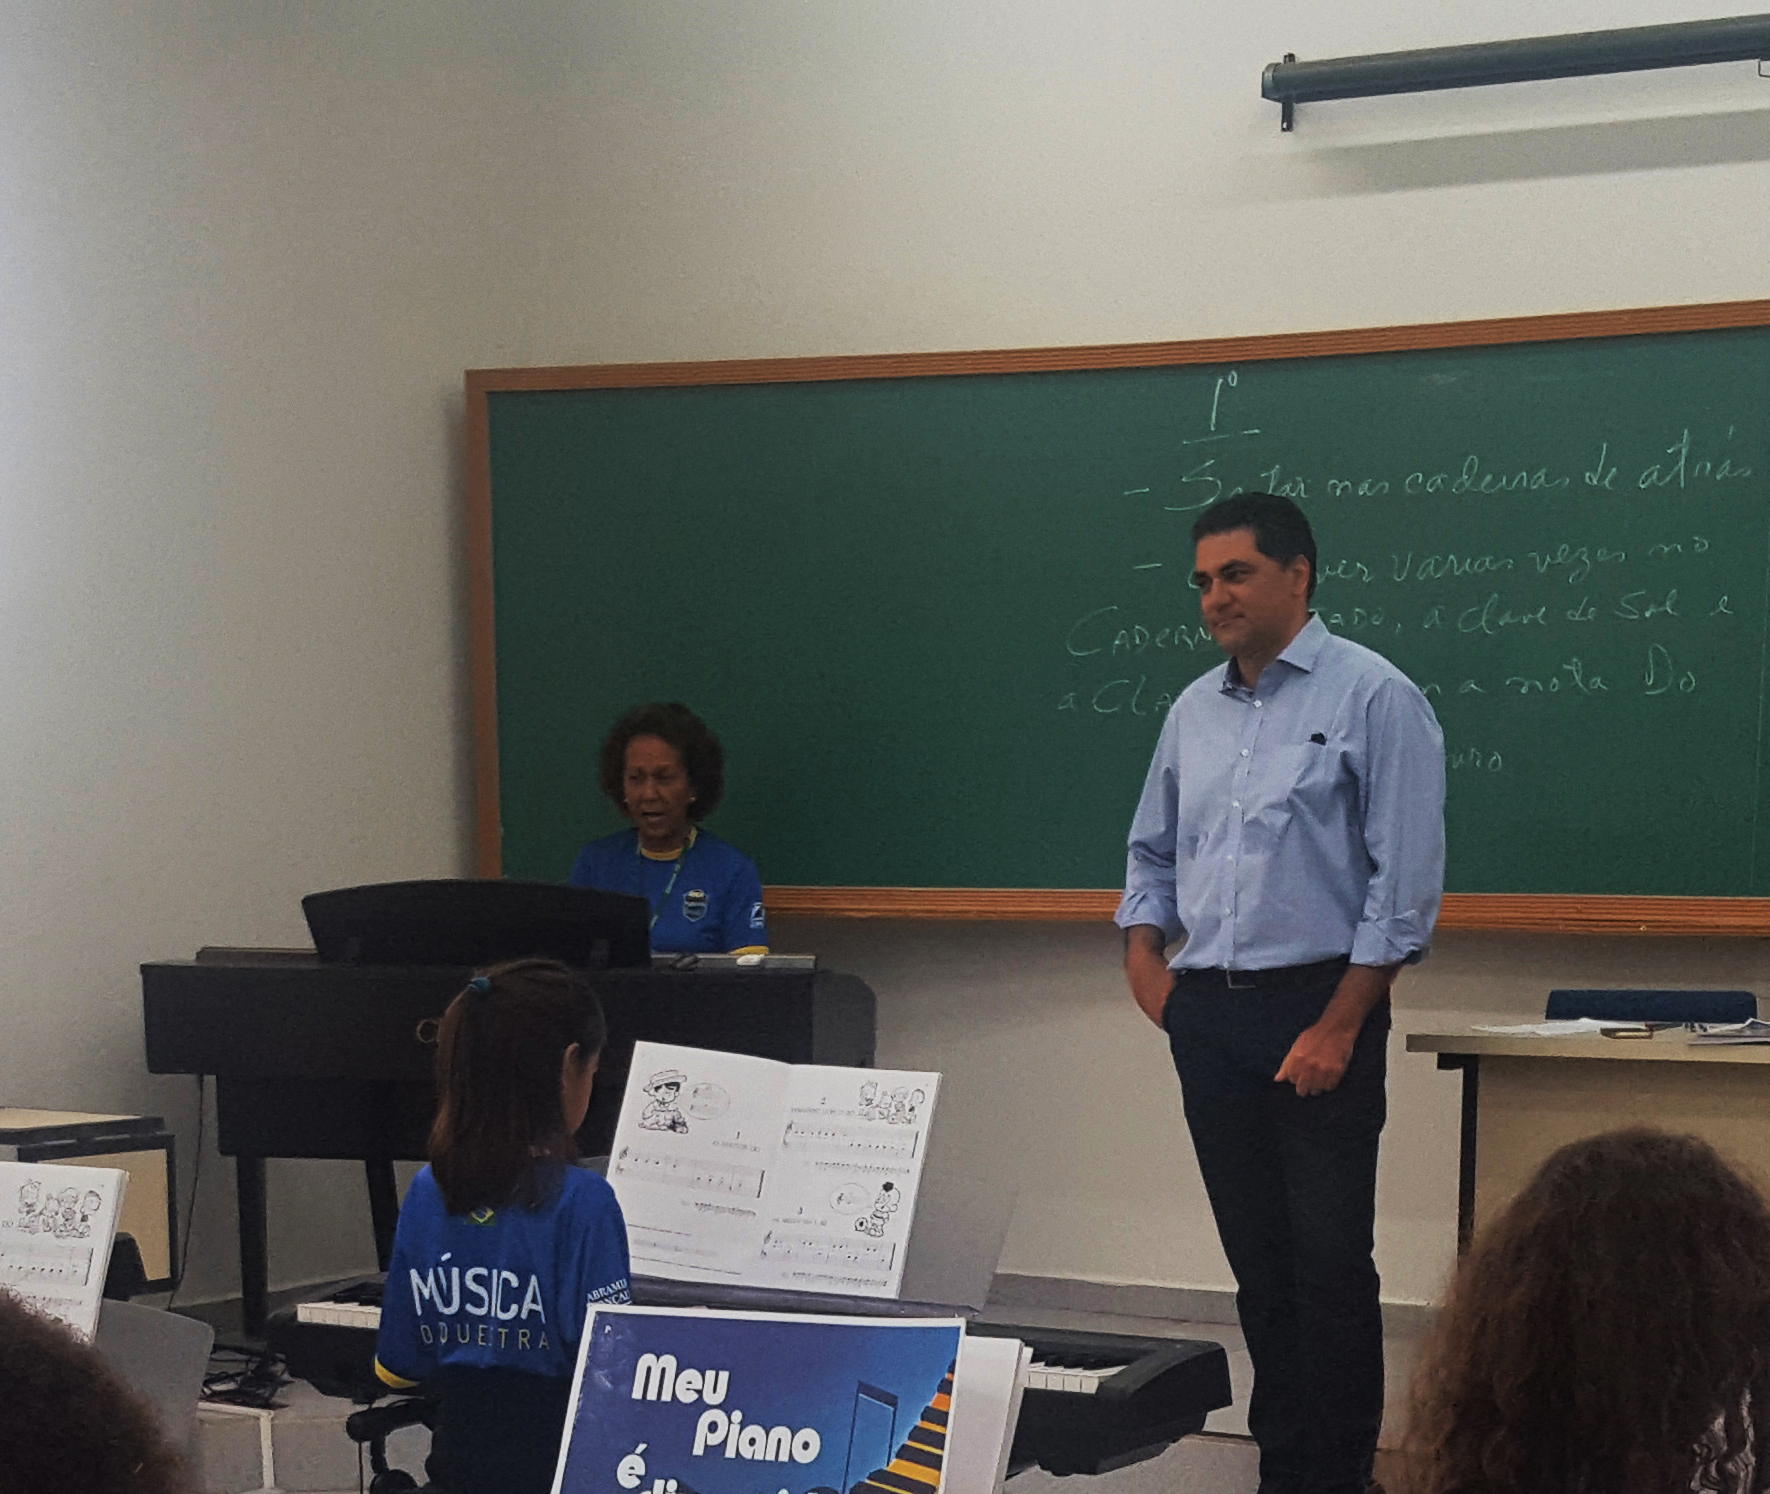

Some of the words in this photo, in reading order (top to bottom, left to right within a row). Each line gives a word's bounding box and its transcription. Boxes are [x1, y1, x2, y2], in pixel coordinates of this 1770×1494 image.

[409, 1251, 547, 1325] MÚSICA
[631, 1353, 730, 1406] Meu
[692, 1409, 822, 1465] Piano
[616, 1443, 648, 1489] é
